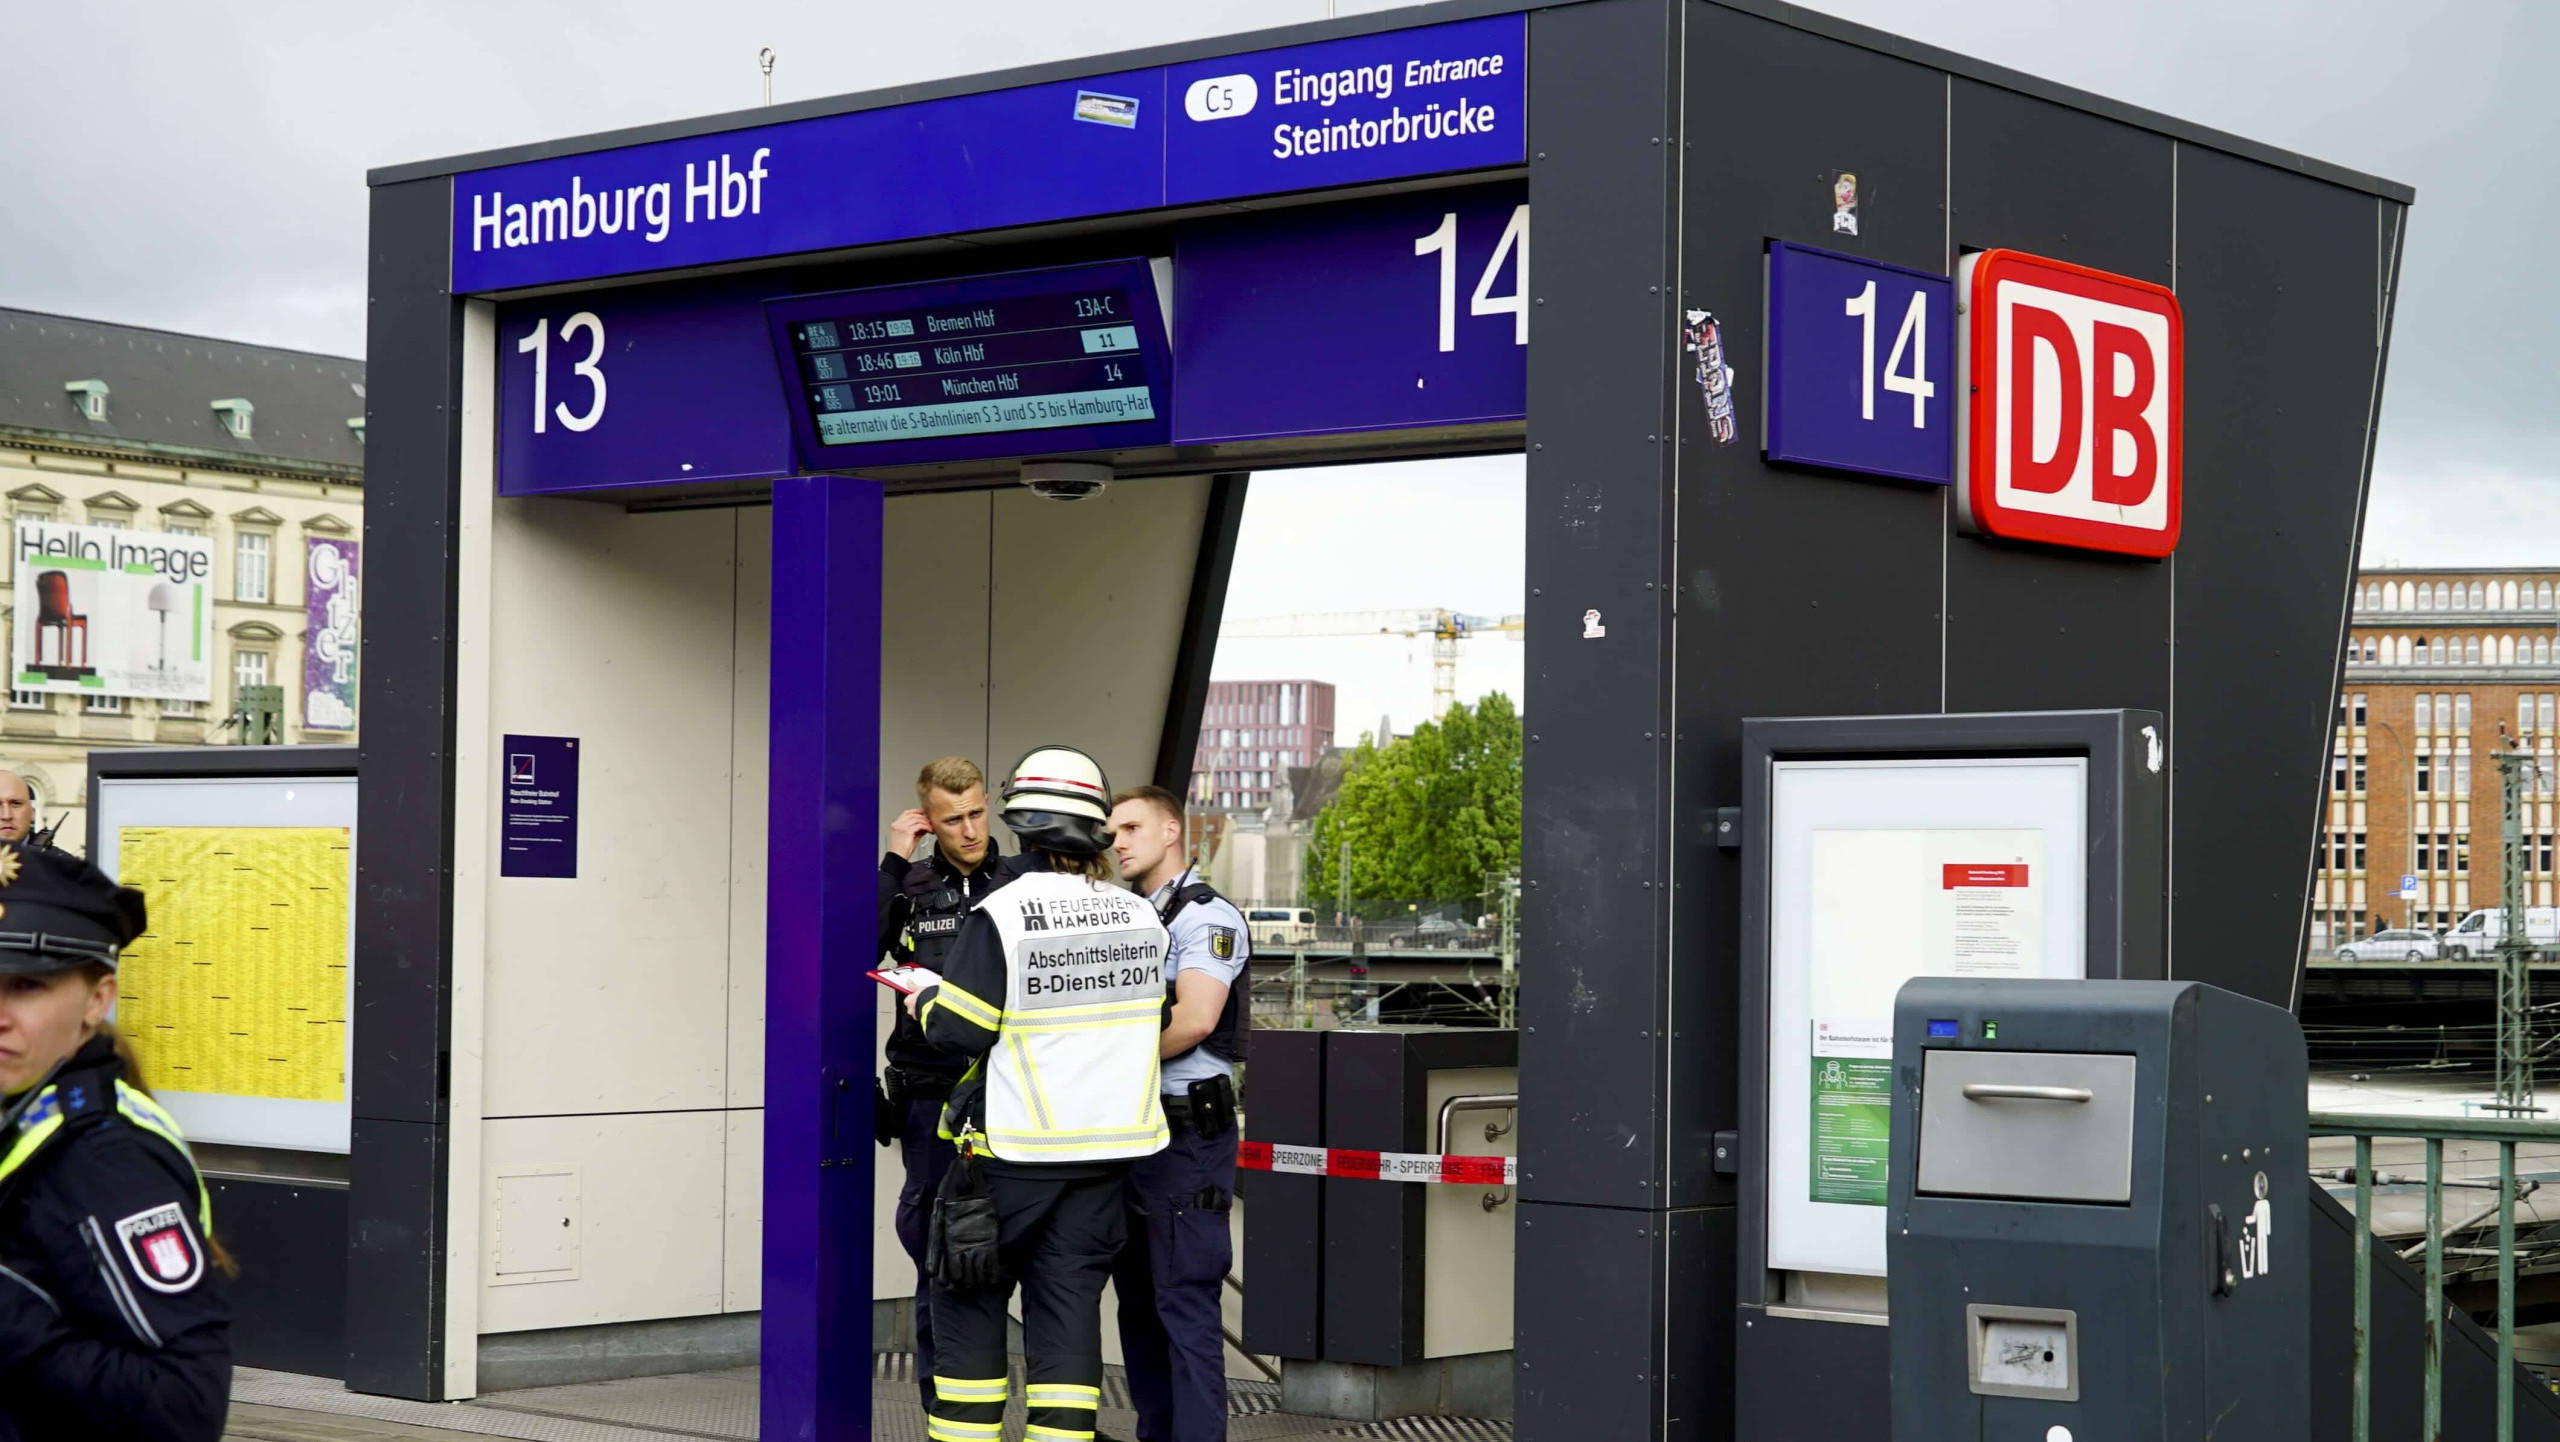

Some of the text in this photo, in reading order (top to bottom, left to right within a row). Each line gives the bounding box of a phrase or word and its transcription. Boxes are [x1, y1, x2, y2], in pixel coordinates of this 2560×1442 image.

[1273, 63, 1393, 107] Eingang
[1404, 53, 1503, 87] Entrance
[1273, 97, 1495, 159] Steintorbrücke
[473, 147, 771, 252] Hamburg Hbf
[1415, 203, 1531, 353] 14
[1075, 296, 1115, 318] 13A-C
[849, 321, 886, 341] 18:15
[889, 322, 913, 334] 19:05
[926, 309, 995, 333] Bremen Hbf
[1099, 333, 1116, 348] 11
[815, 357, 829, 369] ICE
[857, 352, 894, 372] 18:46
[934, 343, 985, 365] Köln Hbf
[1845, 279, 1935, 429] 14
[518, 311, 608, 434] 13
[1104, 363, 1123, 382] 14
[823, 388, 837, 399] ICE
[864, 384, 902, 403] 19:01
[942, 373, 1019, 396] München Hbf
[836, 416, 889, 435] alternativ
[890, 413, 908, 430] die
[910, 408, 982, 430] S-Bahnlinien
[982, 406, 991, 423] S
[992, 405, 1002, 422] 3
[1004, 403, 1027, 421] und
[1027, 402, 1036, 419] S
[1037, 401, 1047, 418] 5
[1049, 398, 1067, 418] bis
[1068, 394, 1150, 417] Hamburg-Har
[2010, 301, 2158, 507] DB
[19, 526, 209, 583] Hello Image
[1049, 896, 1143, 915] FEUERWEHR
[918, 917, 956, 934] POLIZEI
[1052, 911, 1131, 930] HAMBURG
[1027, 942, 1158, 970] Abschnittsleiterin
[1027, 966, 1160, 995] B-Dienst 20/1
[1271, 1151, 1323, 1167] SPERRZONE
[1336, 1155, 1392, 1173] FEUERWEHR
[1399, 1160, 1463, 1176] SPERRZONE
[1480, 1162, 1518, 1178] FEUER
